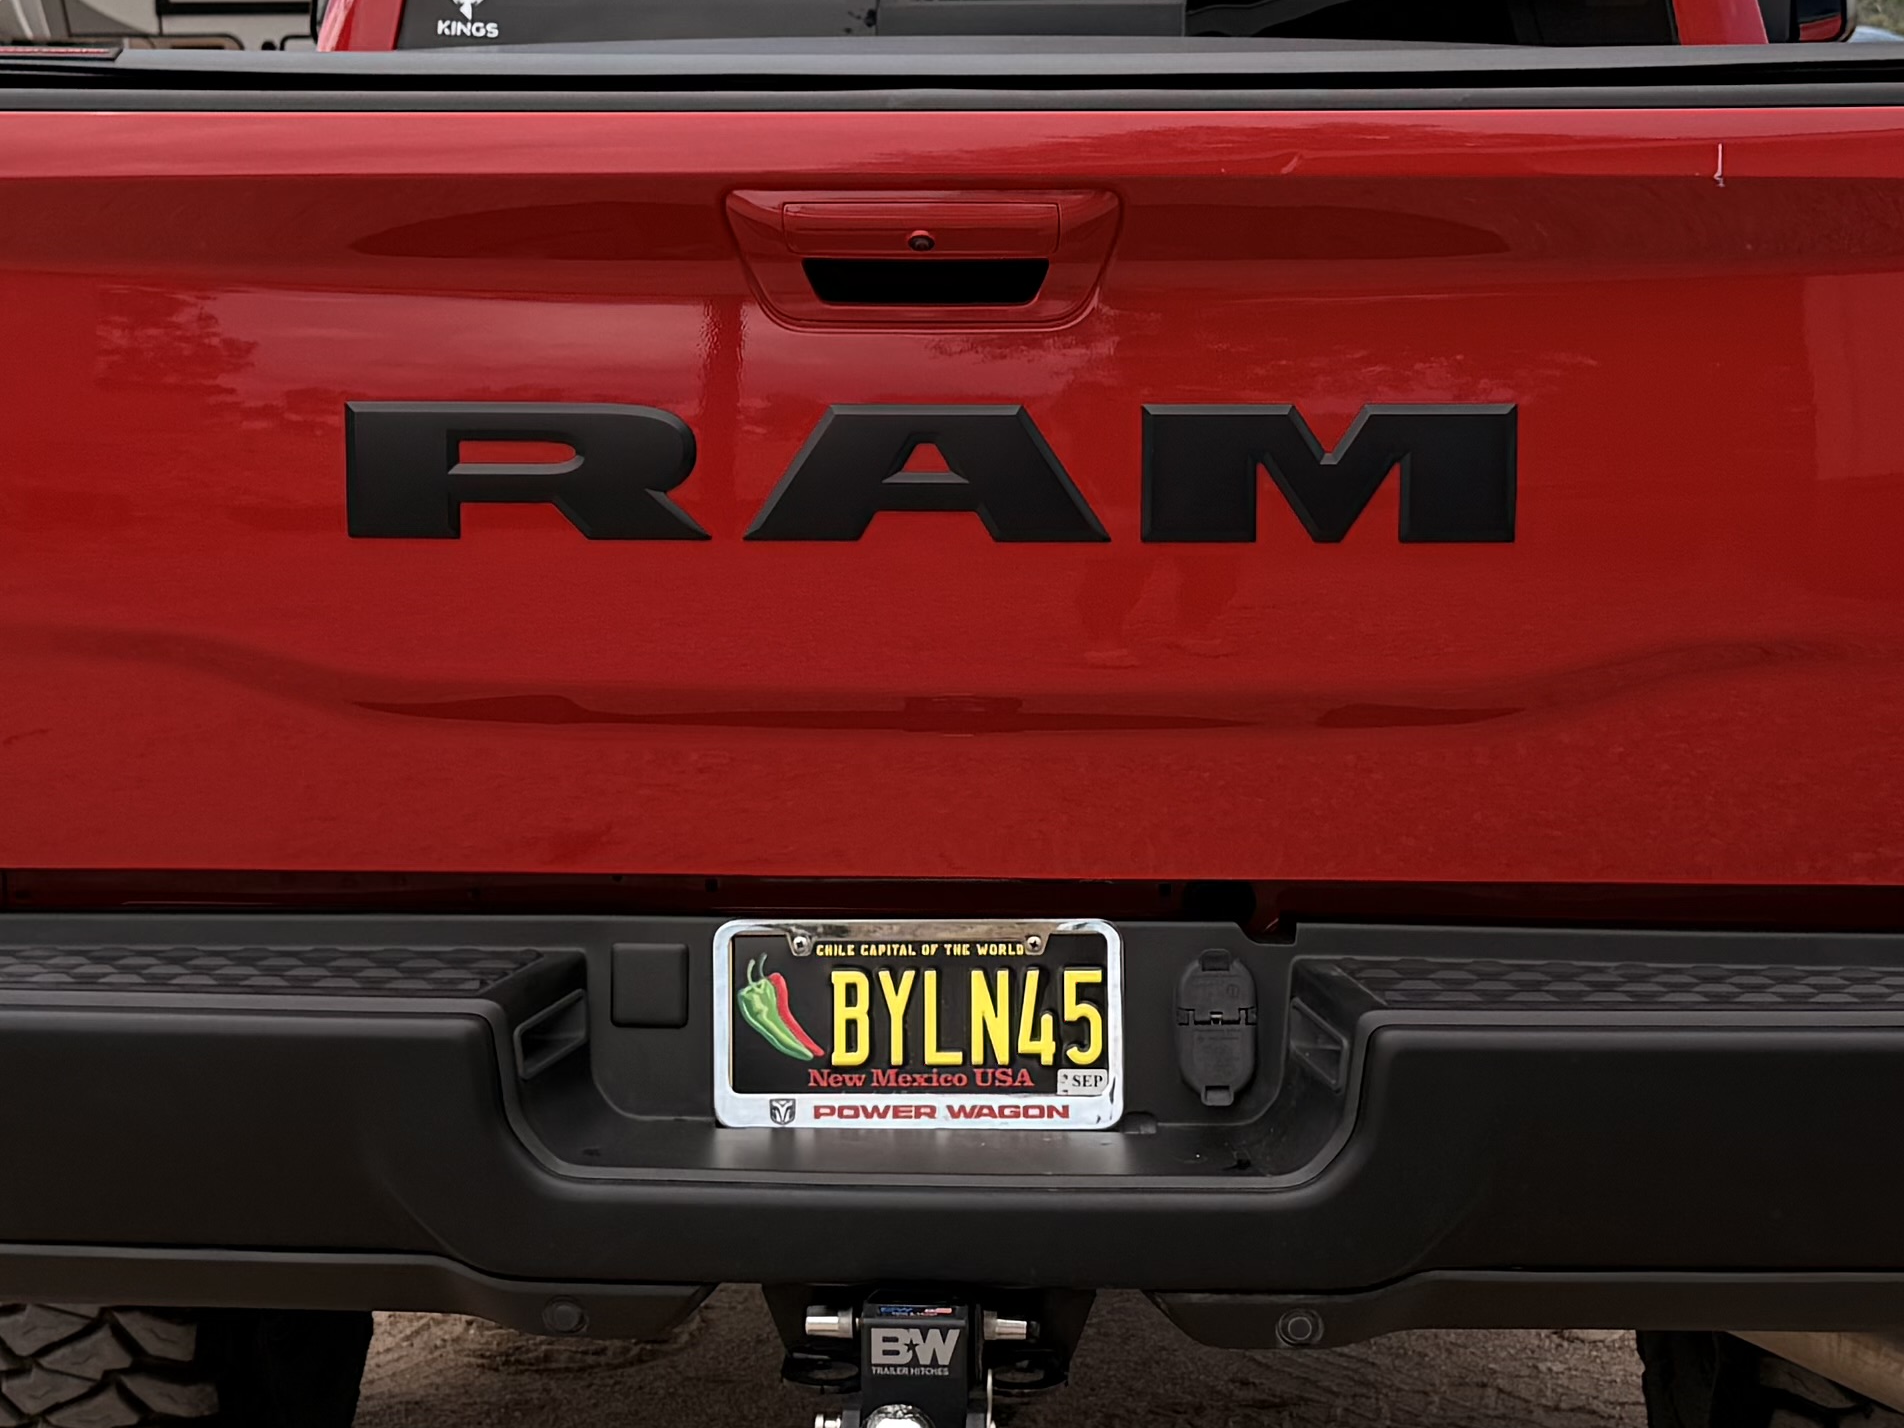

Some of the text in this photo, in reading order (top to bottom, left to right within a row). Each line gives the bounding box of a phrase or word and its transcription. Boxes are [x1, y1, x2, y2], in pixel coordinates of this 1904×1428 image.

[437, 20, 499, 38] KINGS
[344, 401, 1517, 544] RAM
[816, 944, 1024, 956] CHILE CAPITAL OF THE WORLD
[831, 968, 1103, 1066] BYLN45
[808, 1069, 1034, 1087] New Mexico USA
[1072, 1074, 1103, 1087] SEP
[813, 1105, 1069, 1119] POWER WAGON
[871, 1367, 949, 1375] TRAILER HITCHES
